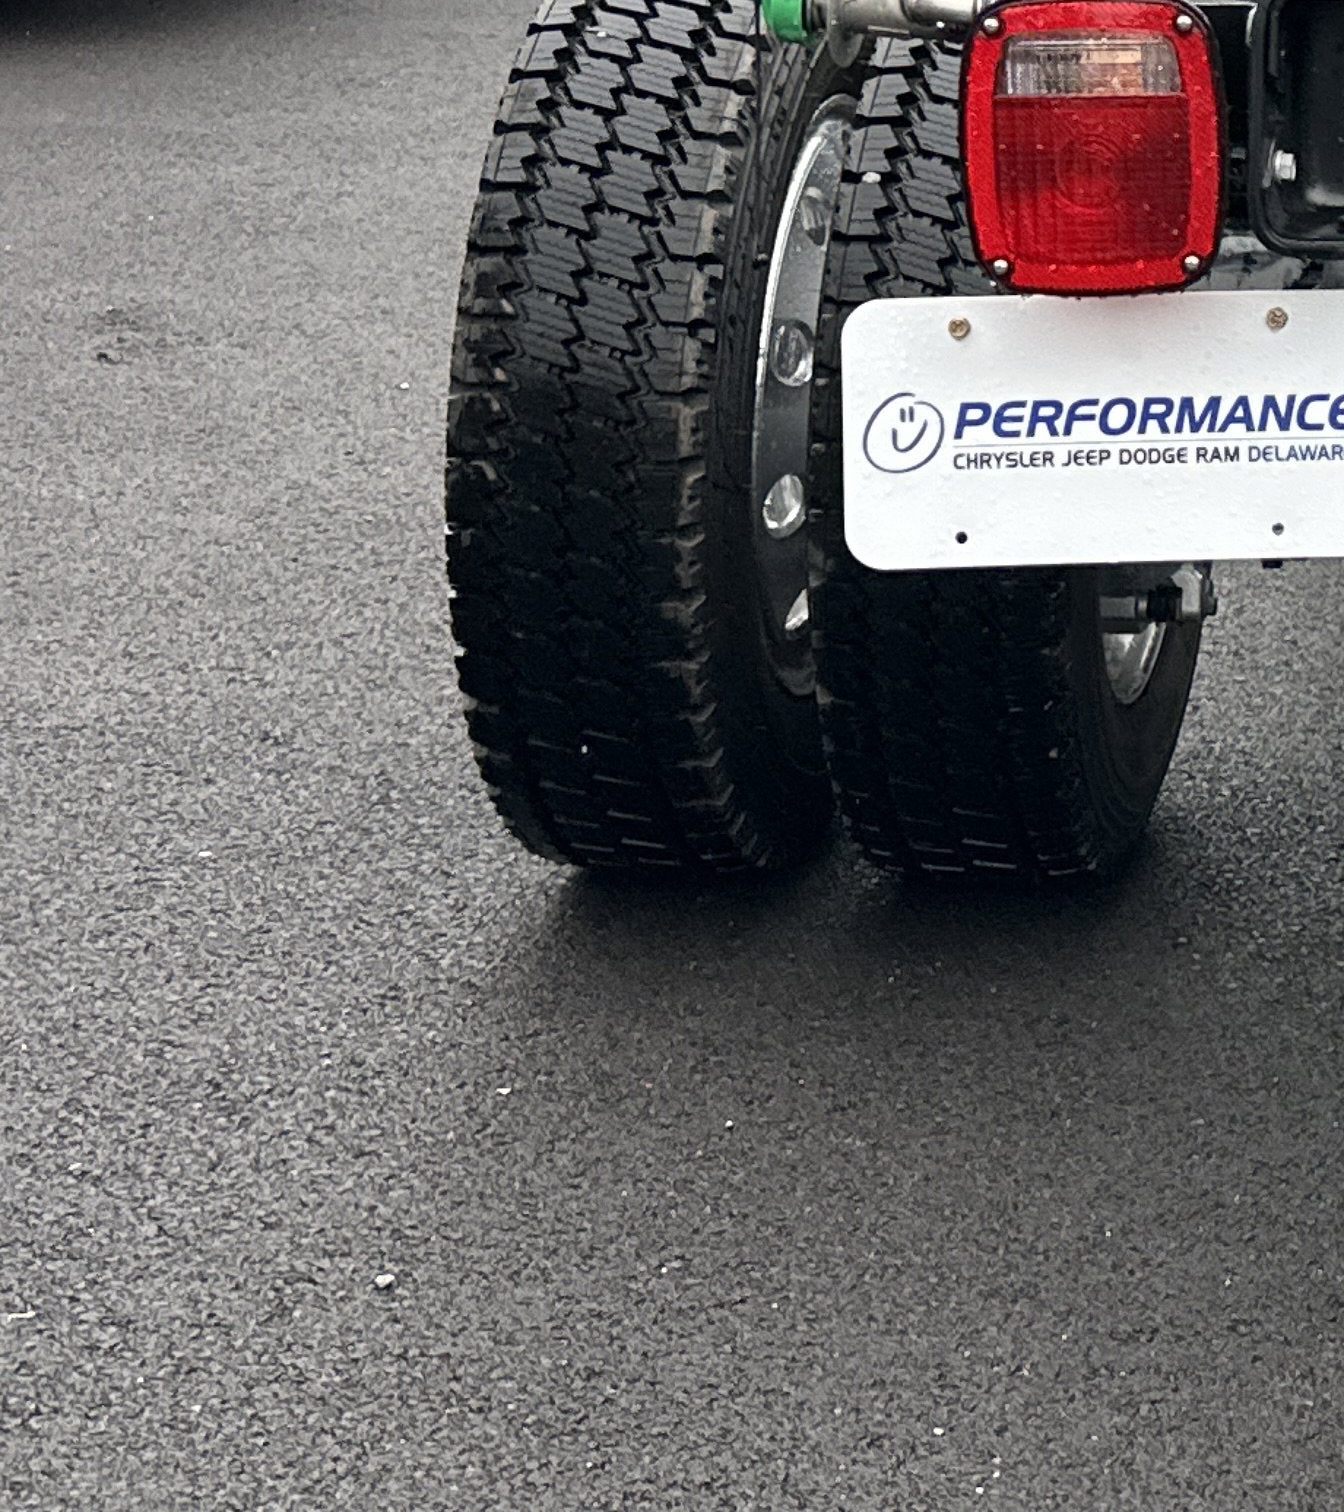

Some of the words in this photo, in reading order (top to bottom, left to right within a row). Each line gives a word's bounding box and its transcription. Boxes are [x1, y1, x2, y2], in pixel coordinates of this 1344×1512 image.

[953, 450, 1055, 470] CHRYSLER
[1061, 448, 1111, 467] JEEP
[1119, 446, 1188, 465] DODGE
[1196, 445, 1240, 464] RAM
